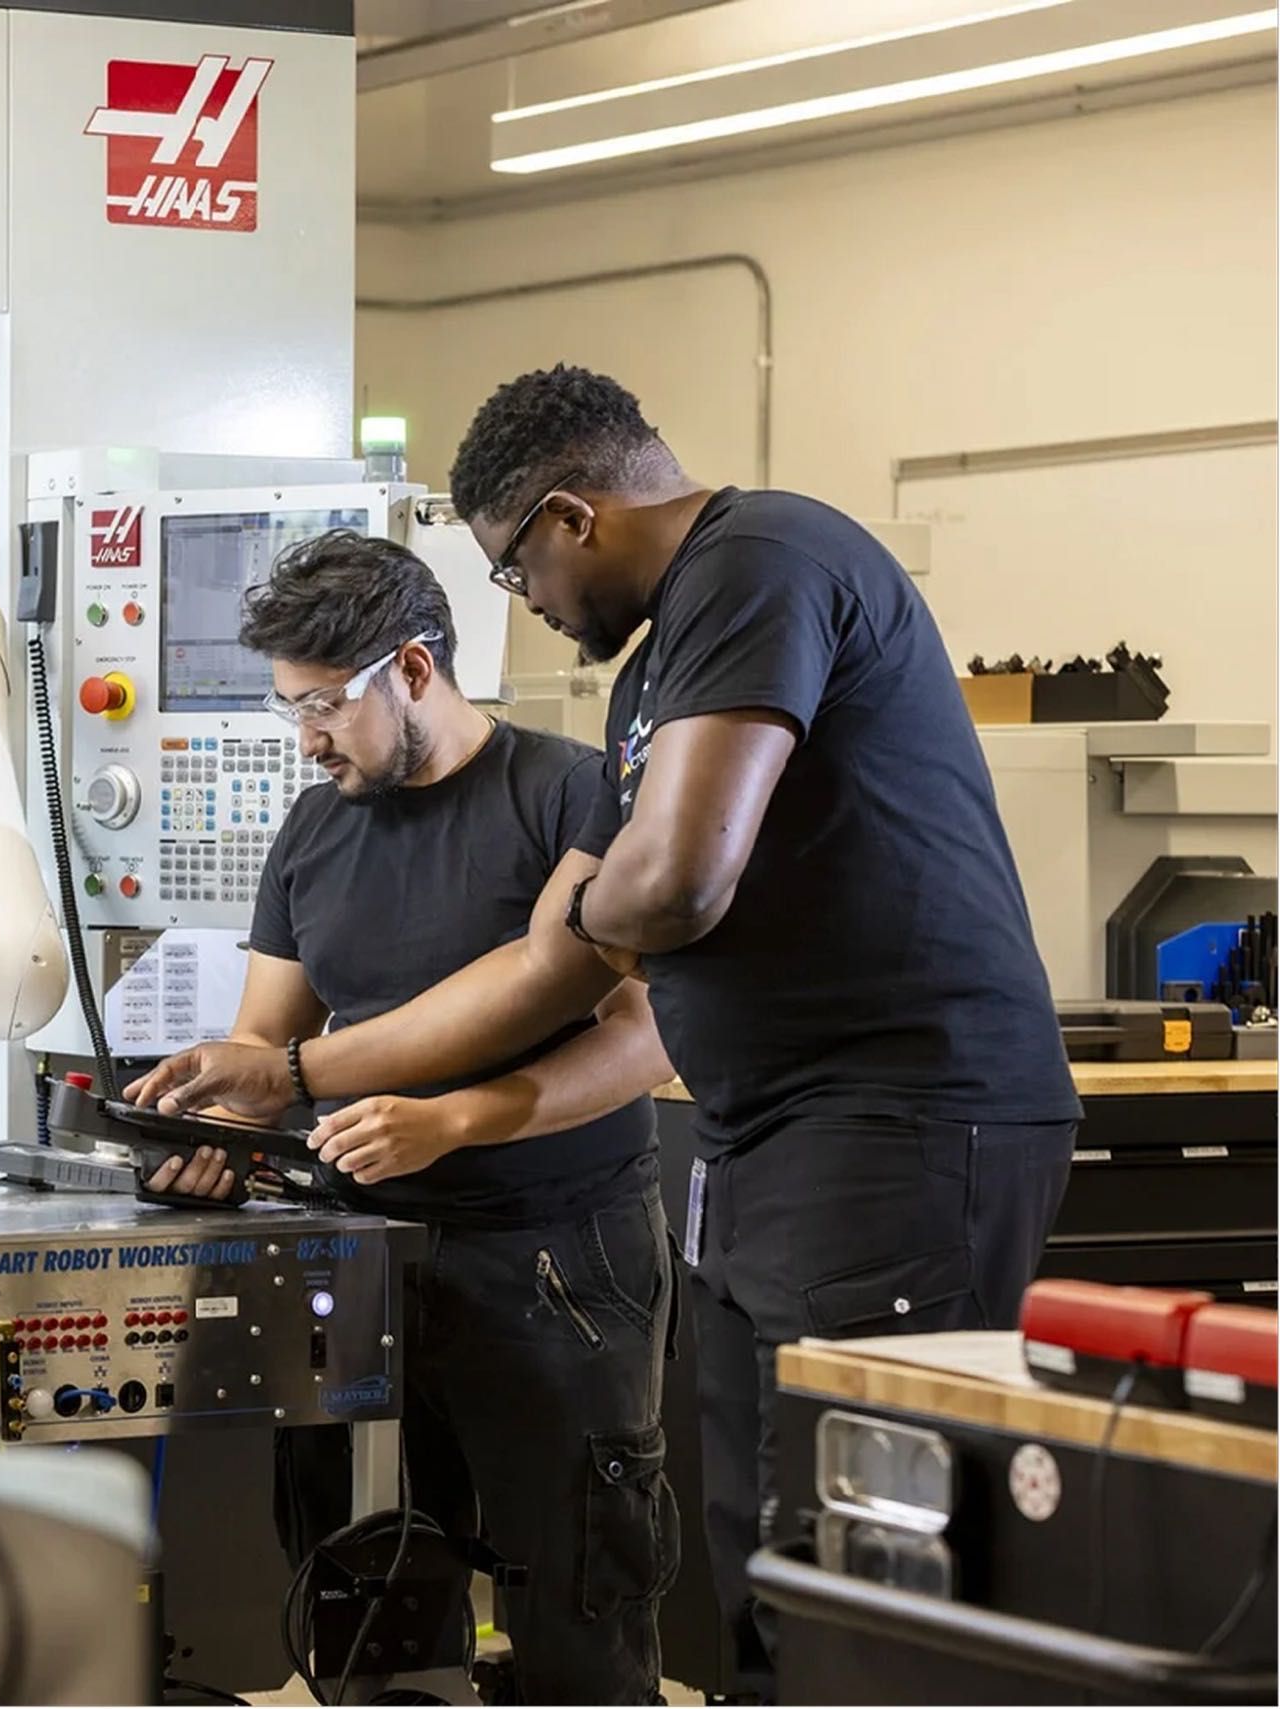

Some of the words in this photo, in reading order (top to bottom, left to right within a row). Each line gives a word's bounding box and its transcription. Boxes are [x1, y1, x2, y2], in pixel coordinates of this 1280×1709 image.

[107, 174, 258, 223] HAAS
[91, 546, 136, 563] HAAS
[44, 1247, 112, 1272] ROBOT
[119, 1242, 257, 1269] WORKSTATION
